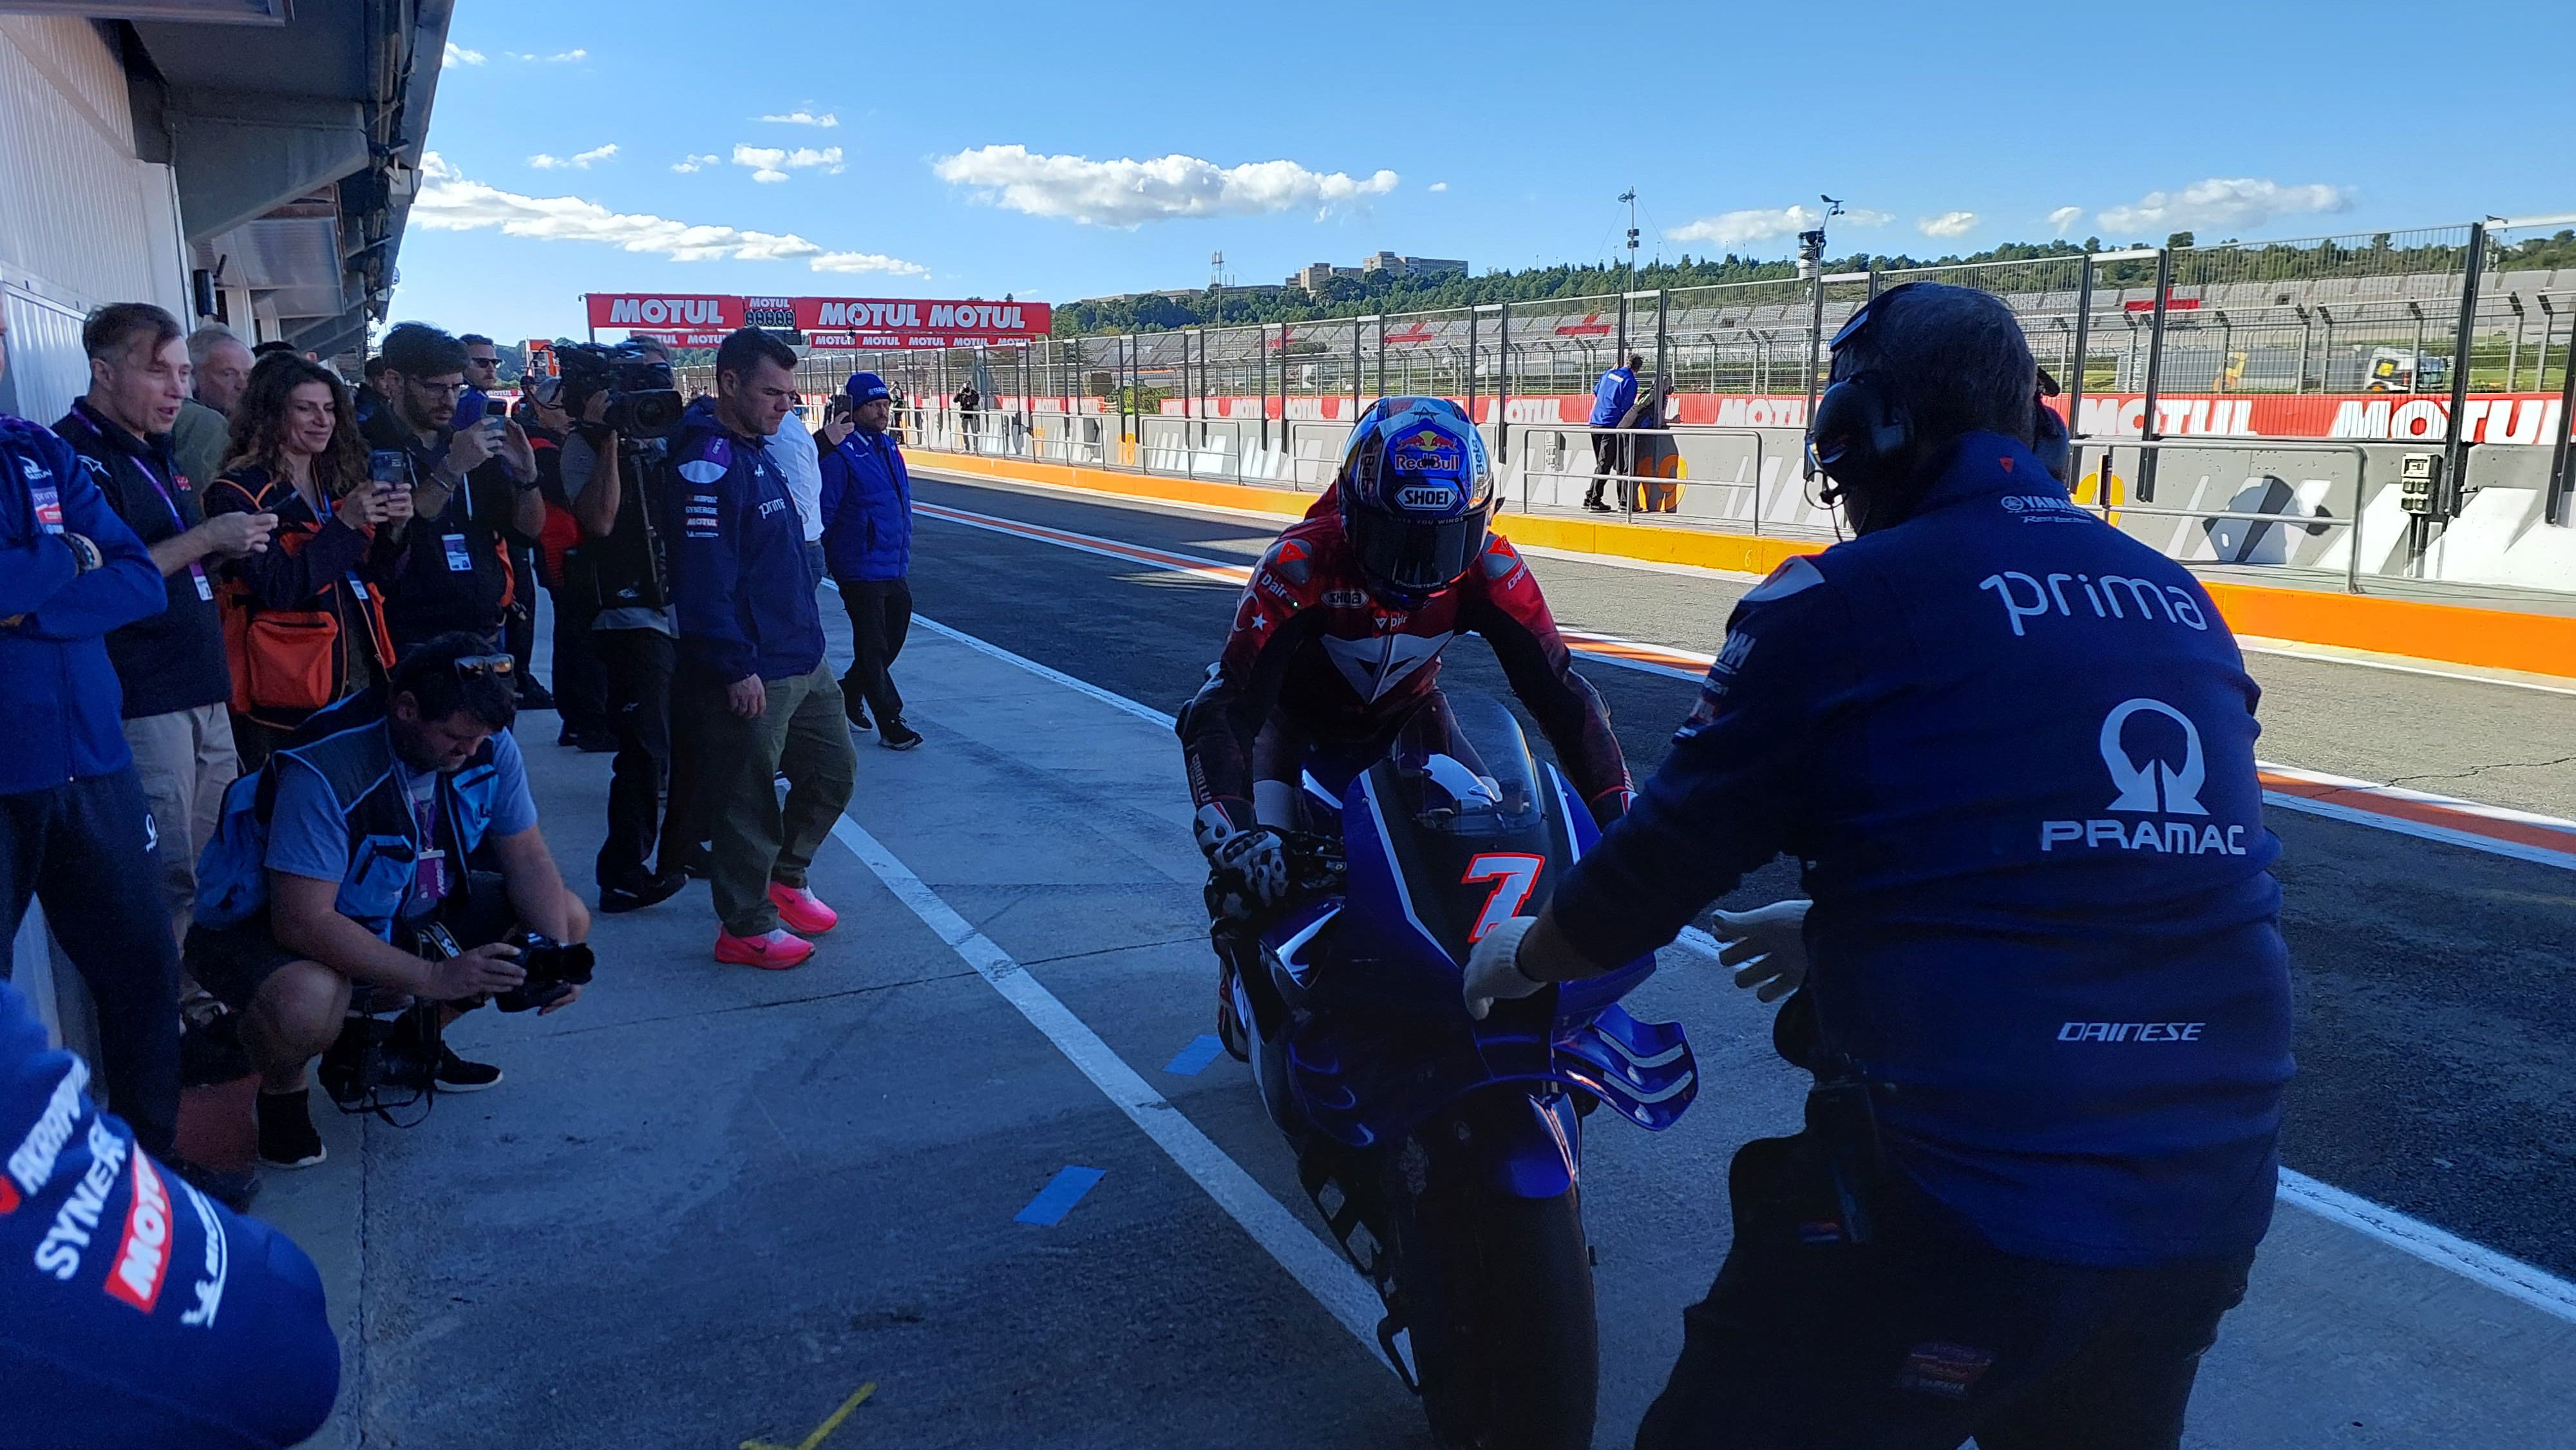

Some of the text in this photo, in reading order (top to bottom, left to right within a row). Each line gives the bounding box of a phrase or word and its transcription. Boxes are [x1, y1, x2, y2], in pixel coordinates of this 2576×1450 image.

[610, 299, 724, 323] MOTUL
[749, 298, 790, 308] MOTUL
[818, 302, 1025, 329] MOTUL MOTUL
[862, 337, 900, 346] MOTUL
[908, 337, 945, 346] MOTUL
[1716, 397, 1822, 426] MOTU
[2076, 397, 2258, 435] MOTUL
[1117, 432, 1136, 466] 18
[1429, 455, 1460, 471] Bull
[1636, 454, 1688, 511] 19
[1404, 490, 1449, 506] SHOEI
[1979, 570, 2208, 636] prima
[2040, 819, 2248, 855] PRAMAC
[1461, 852, 1546, 944] 7
[2057, 1021, 2207, 1042] DAINESE
